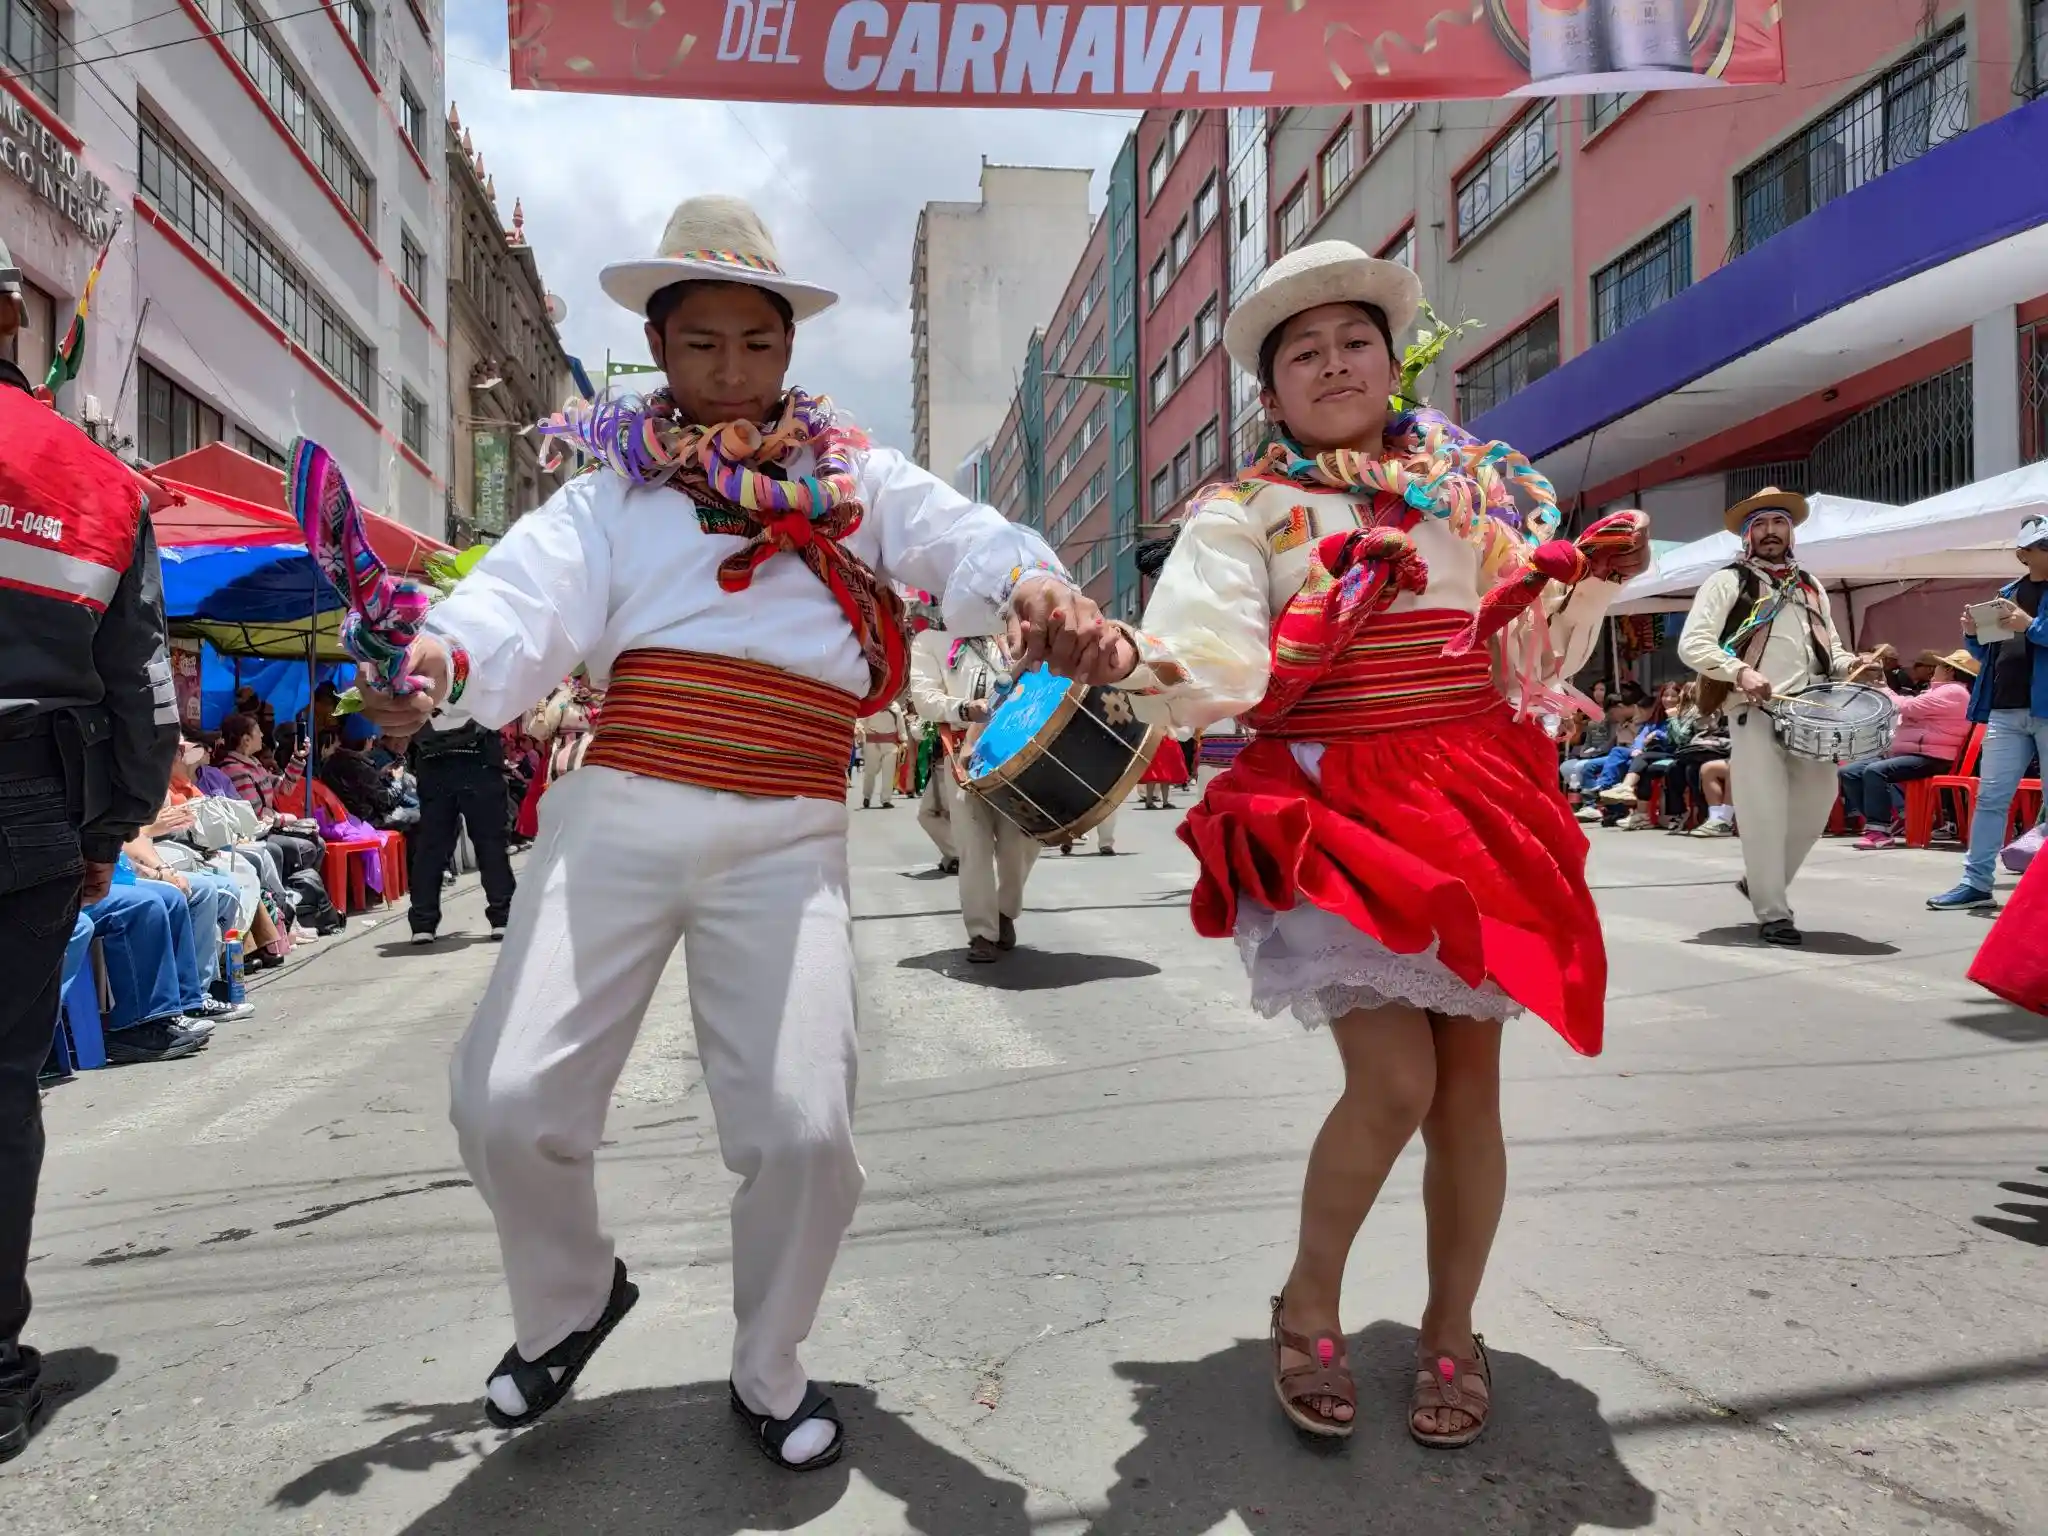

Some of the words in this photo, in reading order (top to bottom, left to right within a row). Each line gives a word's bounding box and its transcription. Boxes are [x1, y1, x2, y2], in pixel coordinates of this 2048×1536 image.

[716, 0, 801, 64] DEL
[823, 0, 1274, 94] CARNAVAL
[39, 163, 108, 246] INTERNO
[87, 171, 110, 213] DE
